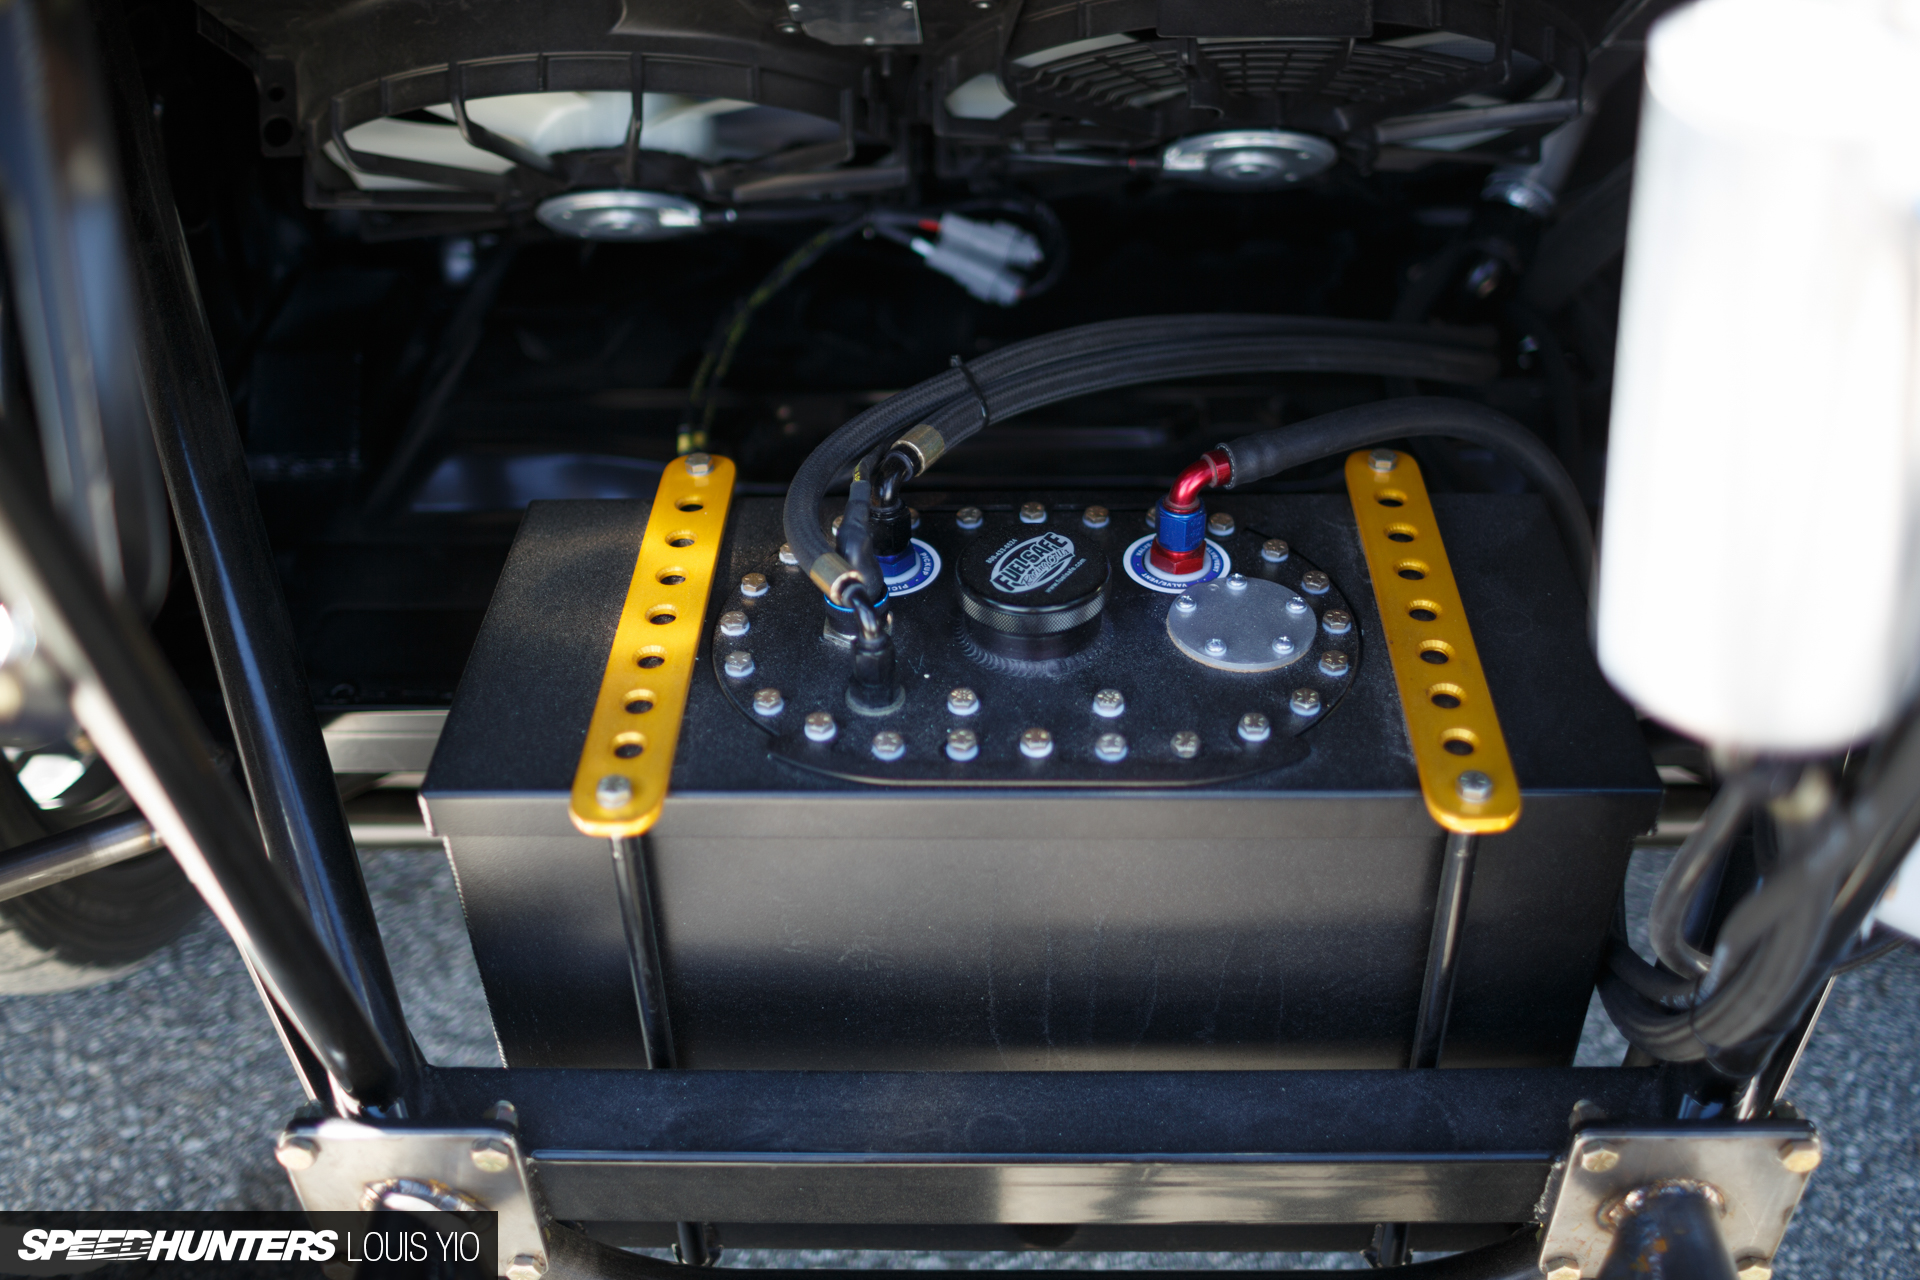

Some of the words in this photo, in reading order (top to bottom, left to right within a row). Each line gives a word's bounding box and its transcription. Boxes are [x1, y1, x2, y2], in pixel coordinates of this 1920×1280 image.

[920, 552, 931, 576] PICKUP
[1020, 562, 1051, 588] Racing
[1141, 572, 1188, 588] VALVE/VENT
